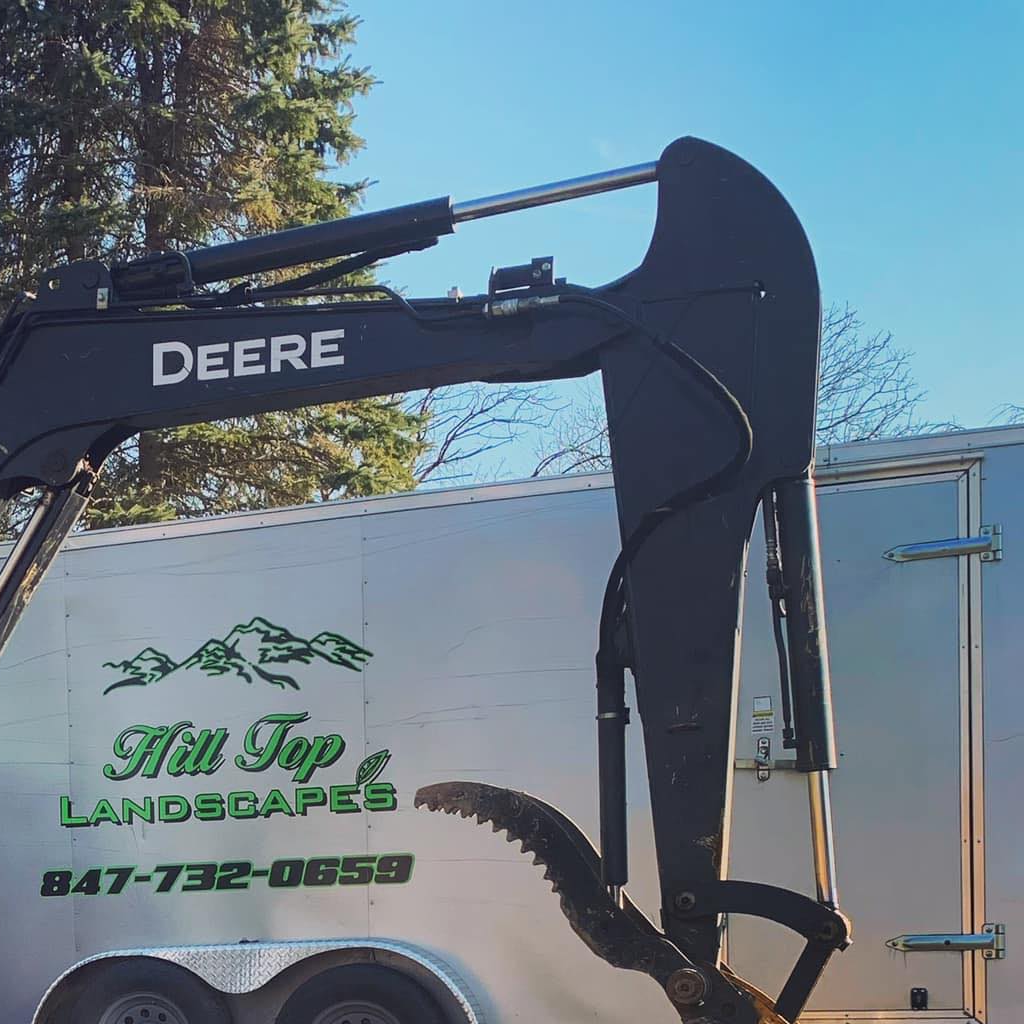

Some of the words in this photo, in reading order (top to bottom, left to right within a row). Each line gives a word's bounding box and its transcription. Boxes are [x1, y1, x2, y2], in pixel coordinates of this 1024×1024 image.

[153, 329, 345, 386] DEERE
[102, 720, 230, 781] Hill
[235, 711, 347, 783] Top
[60, 782, 398, 828] LANDSCAPES
[40, 852, 416, 897] 847-732-0659
